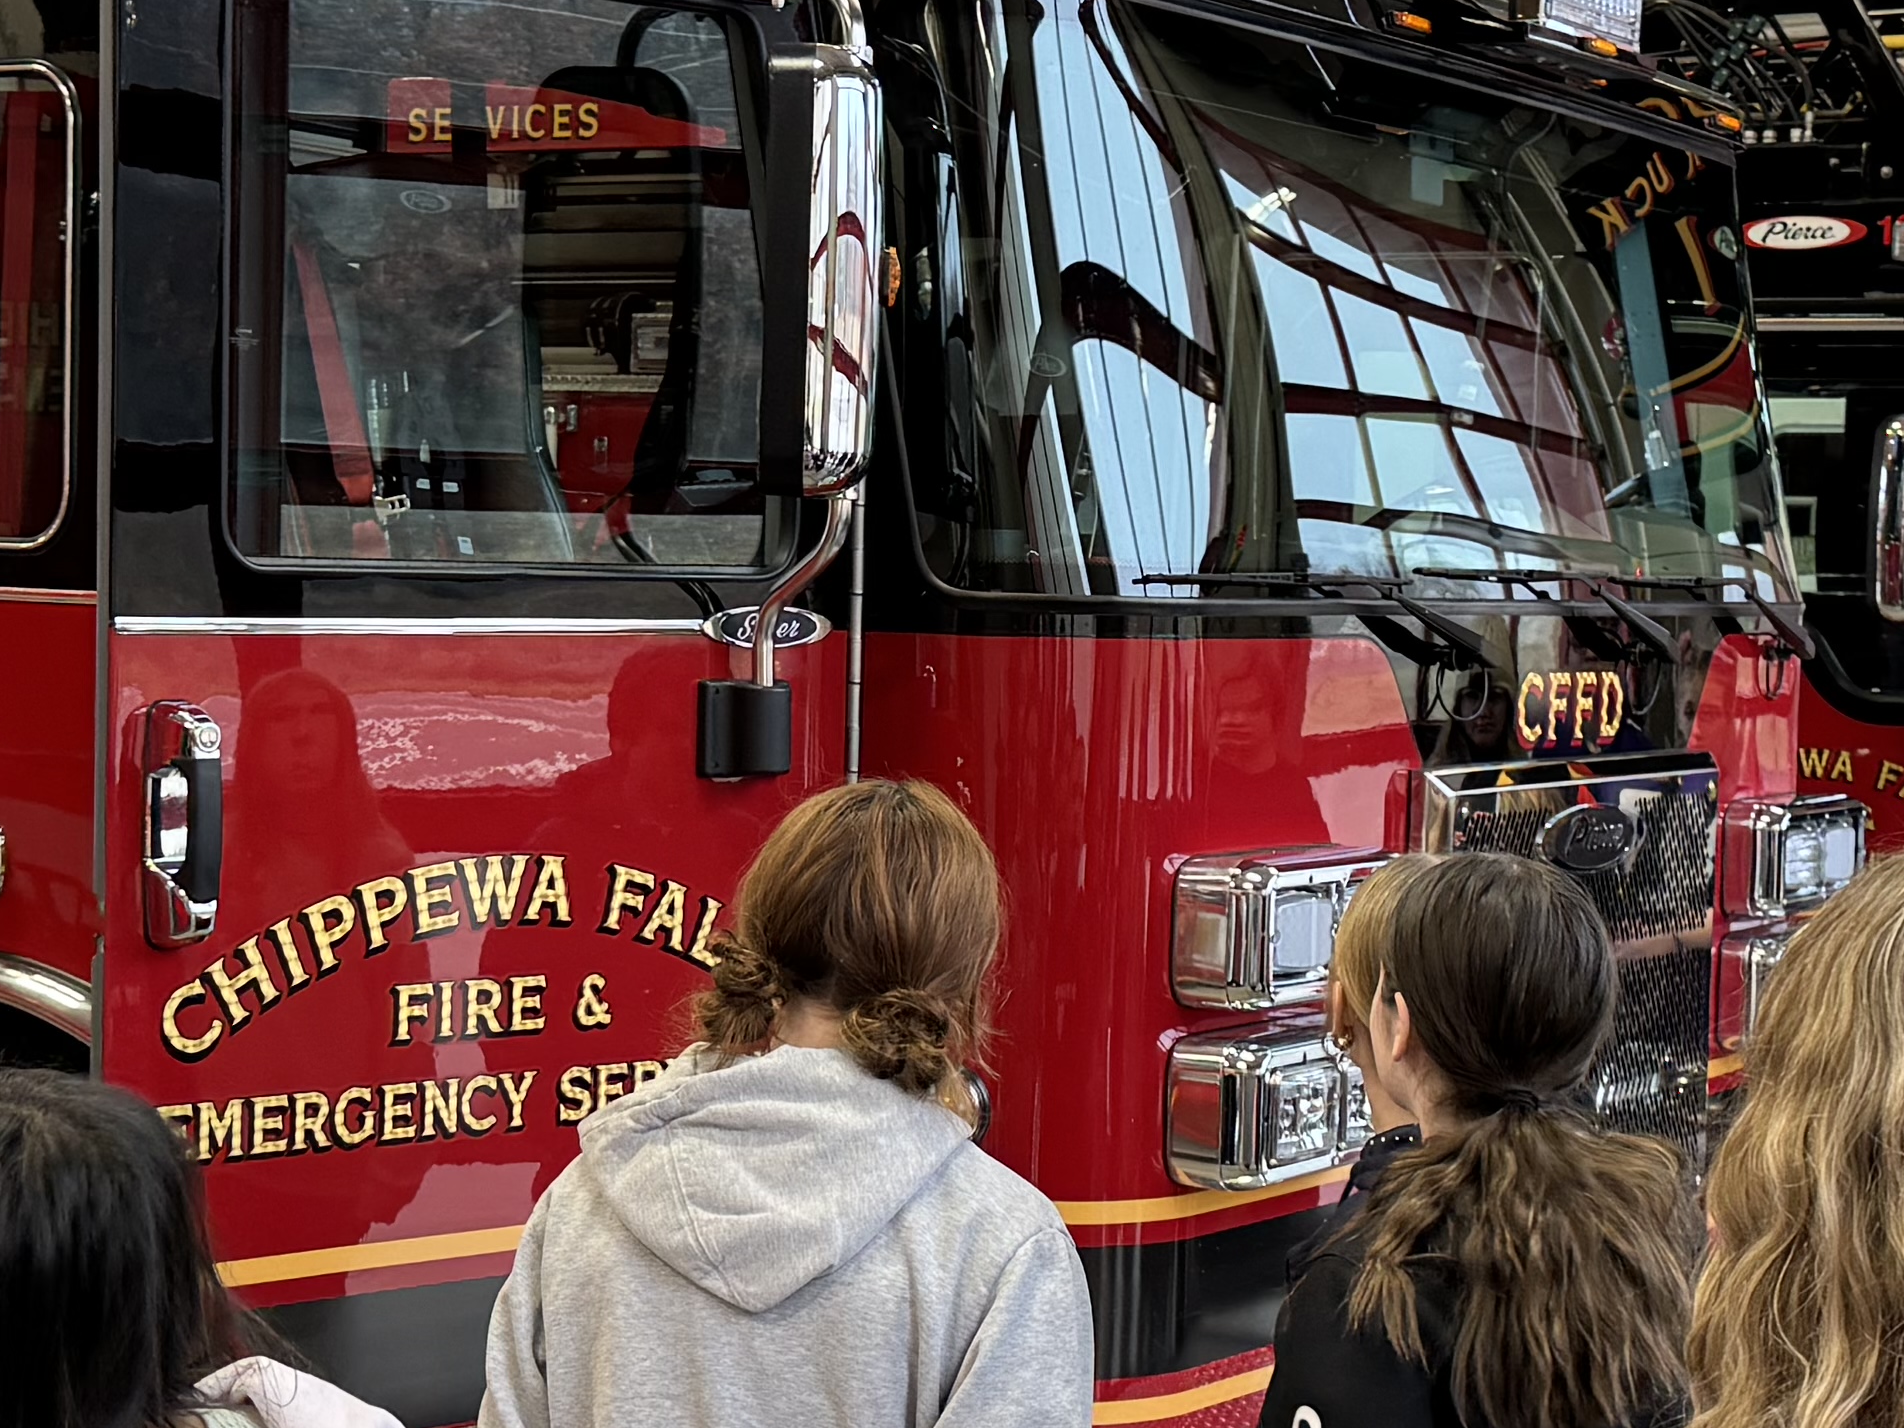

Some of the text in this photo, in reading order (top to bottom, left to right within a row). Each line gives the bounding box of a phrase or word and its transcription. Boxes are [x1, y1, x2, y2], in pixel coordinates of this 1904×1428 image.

[408, 102, 599, 142] SEVICES
[1761, 220, 1836, 244] Pierce
[737, 613, 800, 640] Ser
[1517, 671, 1624, 749] CFFD
[162, 855, 722, 1054] CHIPPEWA FAL
[393, 974, 612, 1041] FIRE &
